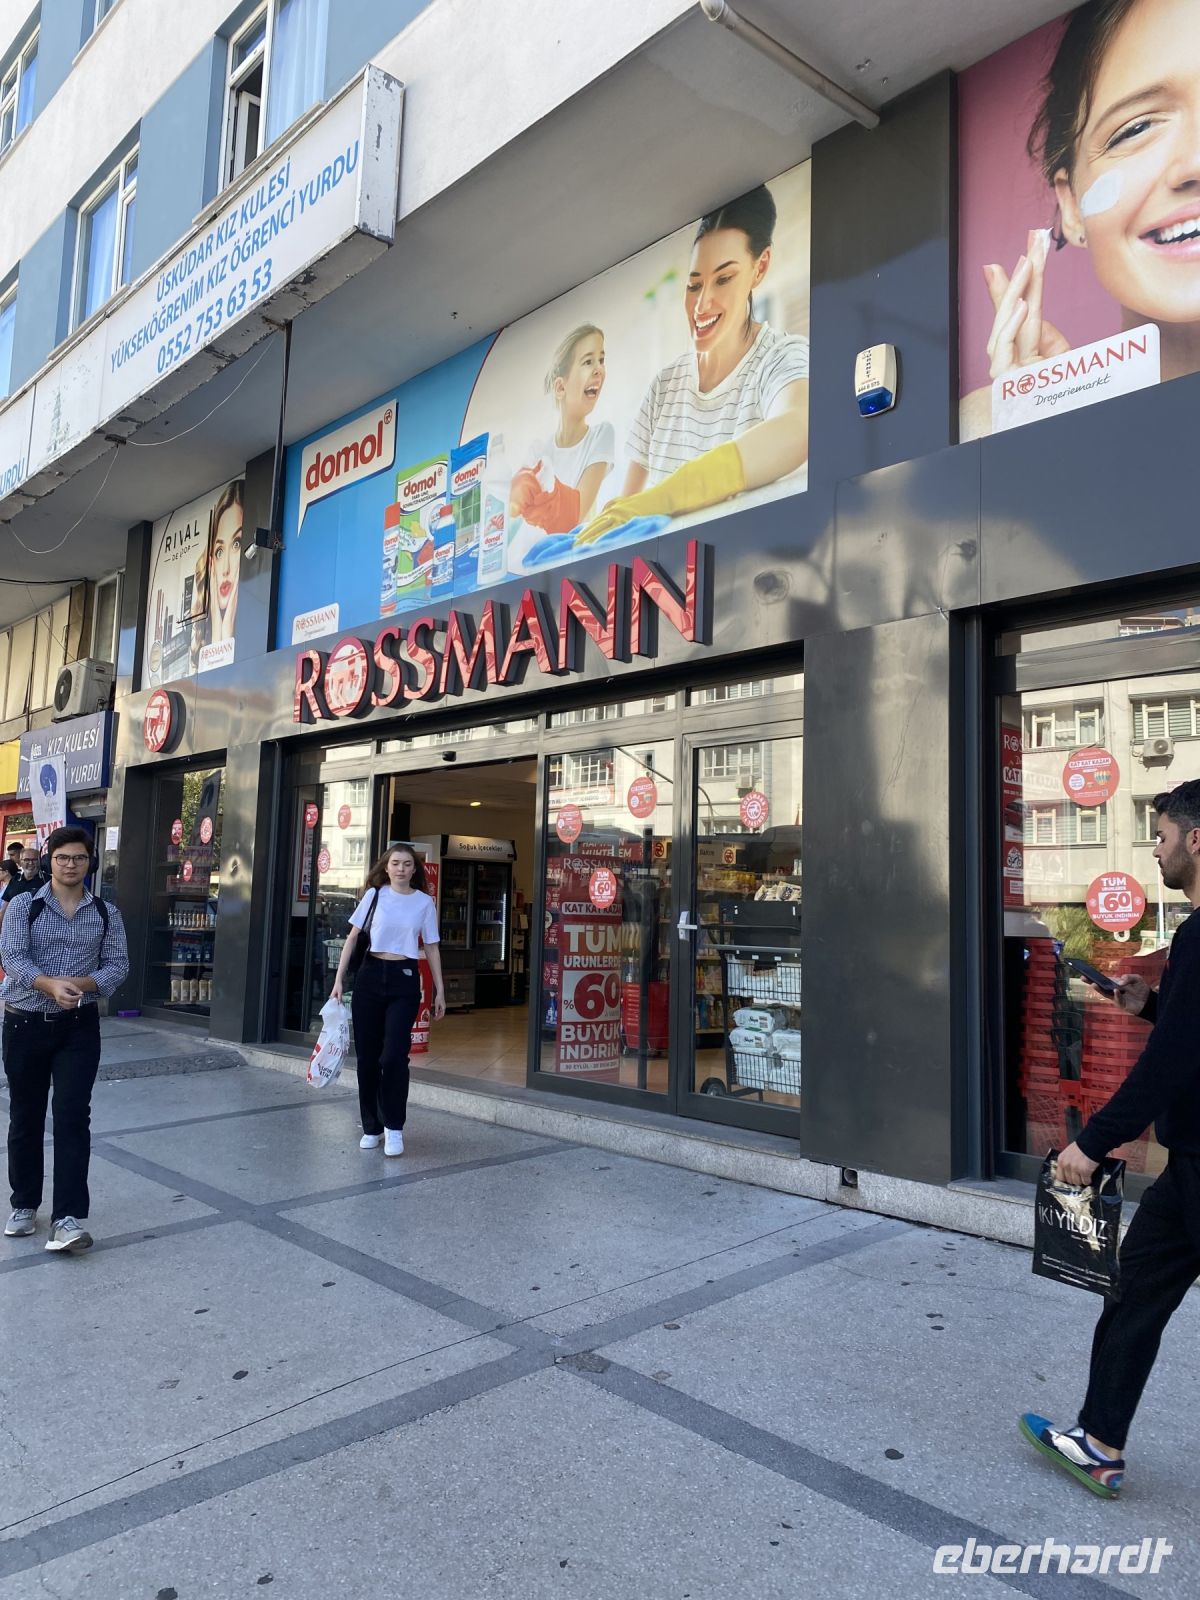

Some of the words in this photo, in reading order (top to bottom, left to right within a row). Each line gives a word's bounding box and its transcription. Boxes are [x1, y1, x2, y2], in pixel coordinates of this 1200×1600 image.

[156, 232, 214, 303] ÜSKÜDAR
[215, 209, 240, 251] KIZ
[240, 154, 292, 230] KULESİ
[110, 274, 206, 374] YÜKSEKÖĞRENİM
[206, 253, 229, 295] KIZ
[230, 189, 297, 273] ÖĞRENCİ
[299, 139, 360, 215] YURDU
[157, 323, 193, 374] 0552
[195, 297, 223, 344] 753
[226, 278, 247, 318] 63
[250, 257, 273, 301] 53
[1002, 334, 1147, 401] ROSSMANN
[1033, 372, 1111, 407] Drogeriemarkt
[305, 419, 384, 491] domol
[0, 457, 25, 496] URDU
[403, 471, 437, 498] domol
[454, 465, 480, 484] domol
[164, 519, 200, 554] RIVAL
[484, 534, 501, 545] domol
[293, 540, 712, 724] ROSSMANN
[294, 608, 337, 631] ROSSMANN
[200, 642, 233, 661] ROSSMANN
[47, 736, 63, 755] KIZ
[64, 720, 101, 753] KULESİ
[70, 761, 101, 785] YURDU
[1100, 876, 1127, 887] TÜM
[564, 903, 583, 914] KAT
[563, 924, 622, 953] TÜM
[561, 1023, 620, 1042] BÜYÜK
